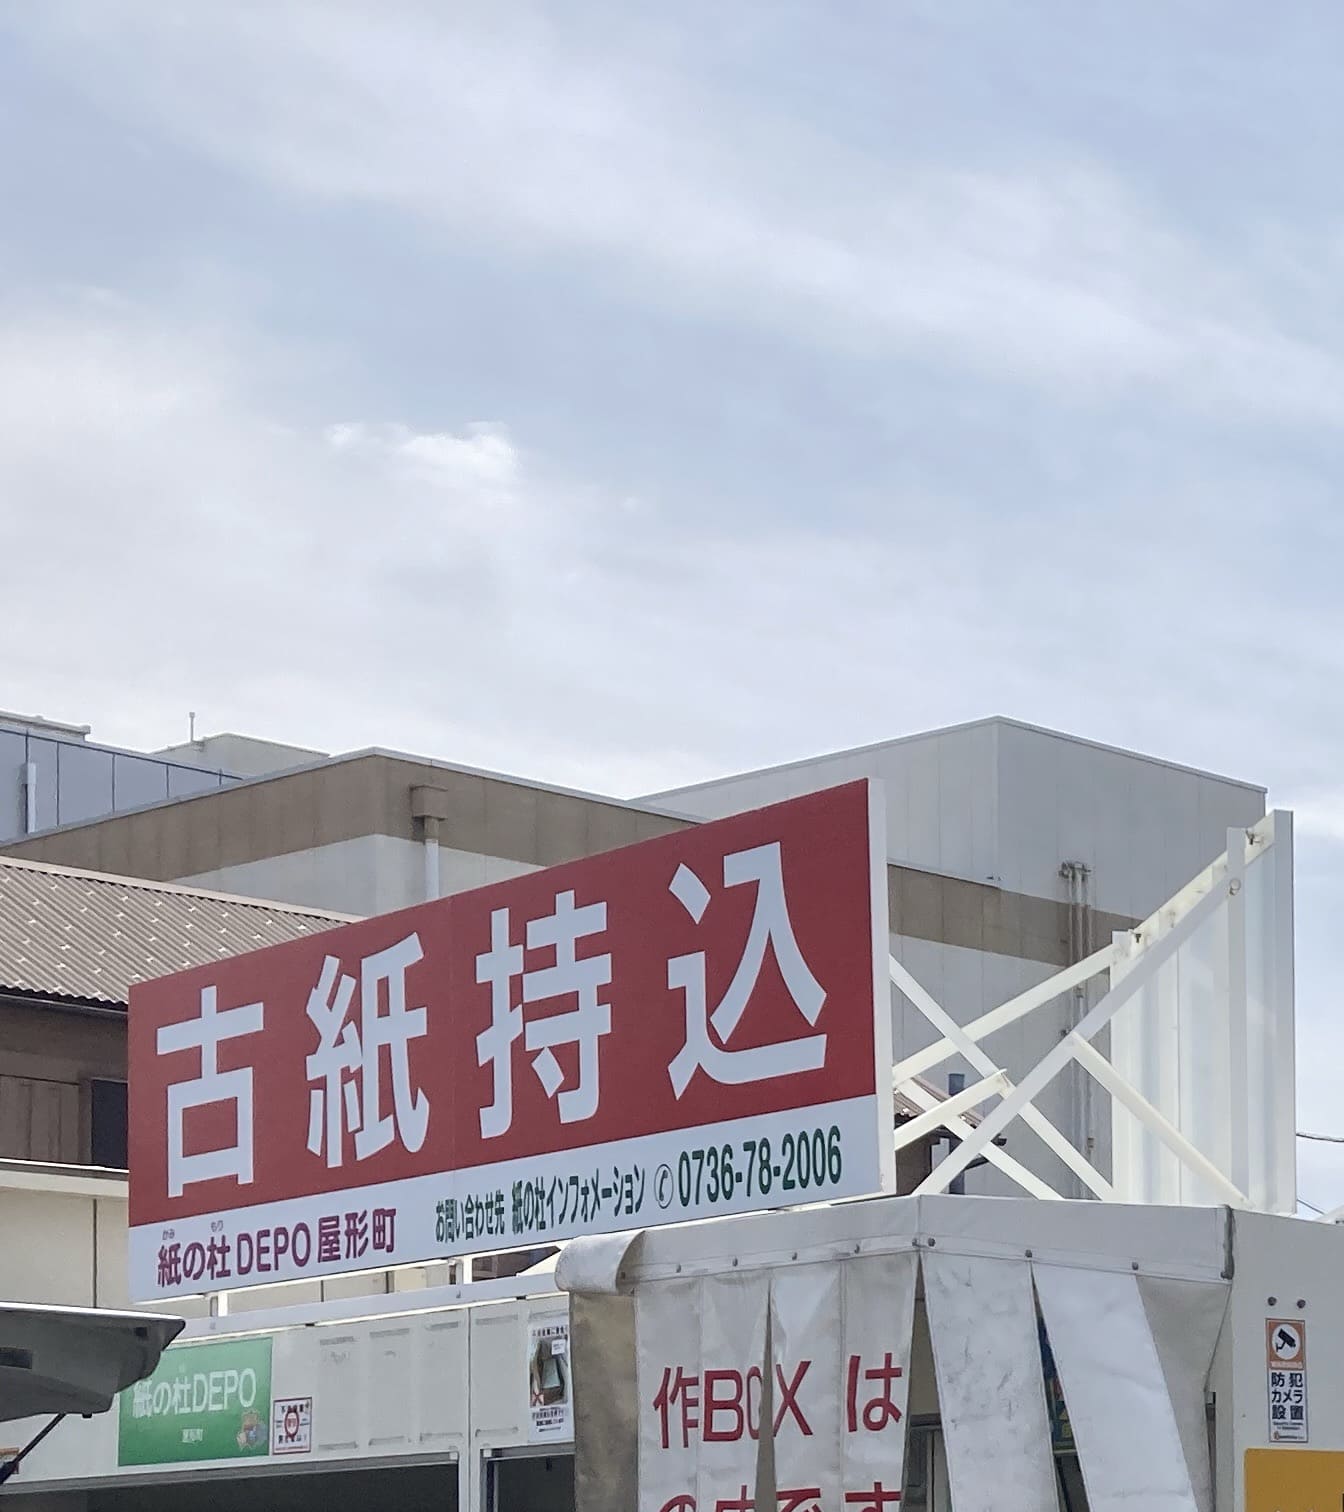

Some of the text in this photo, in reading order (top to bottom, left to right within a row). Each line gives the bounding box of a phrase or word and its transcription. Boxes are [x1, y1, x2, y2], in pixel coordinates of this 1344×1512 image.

[155, 840, 829, 1198] 古紙持込
[435, 1124, 843, 1244] お問い合わせ先 紙の杜インフォメーション 0736-78-2006
[1271, 1371, 1304, 1388] 防犯
[1271, 1388, 1304, 1404] カメラ
